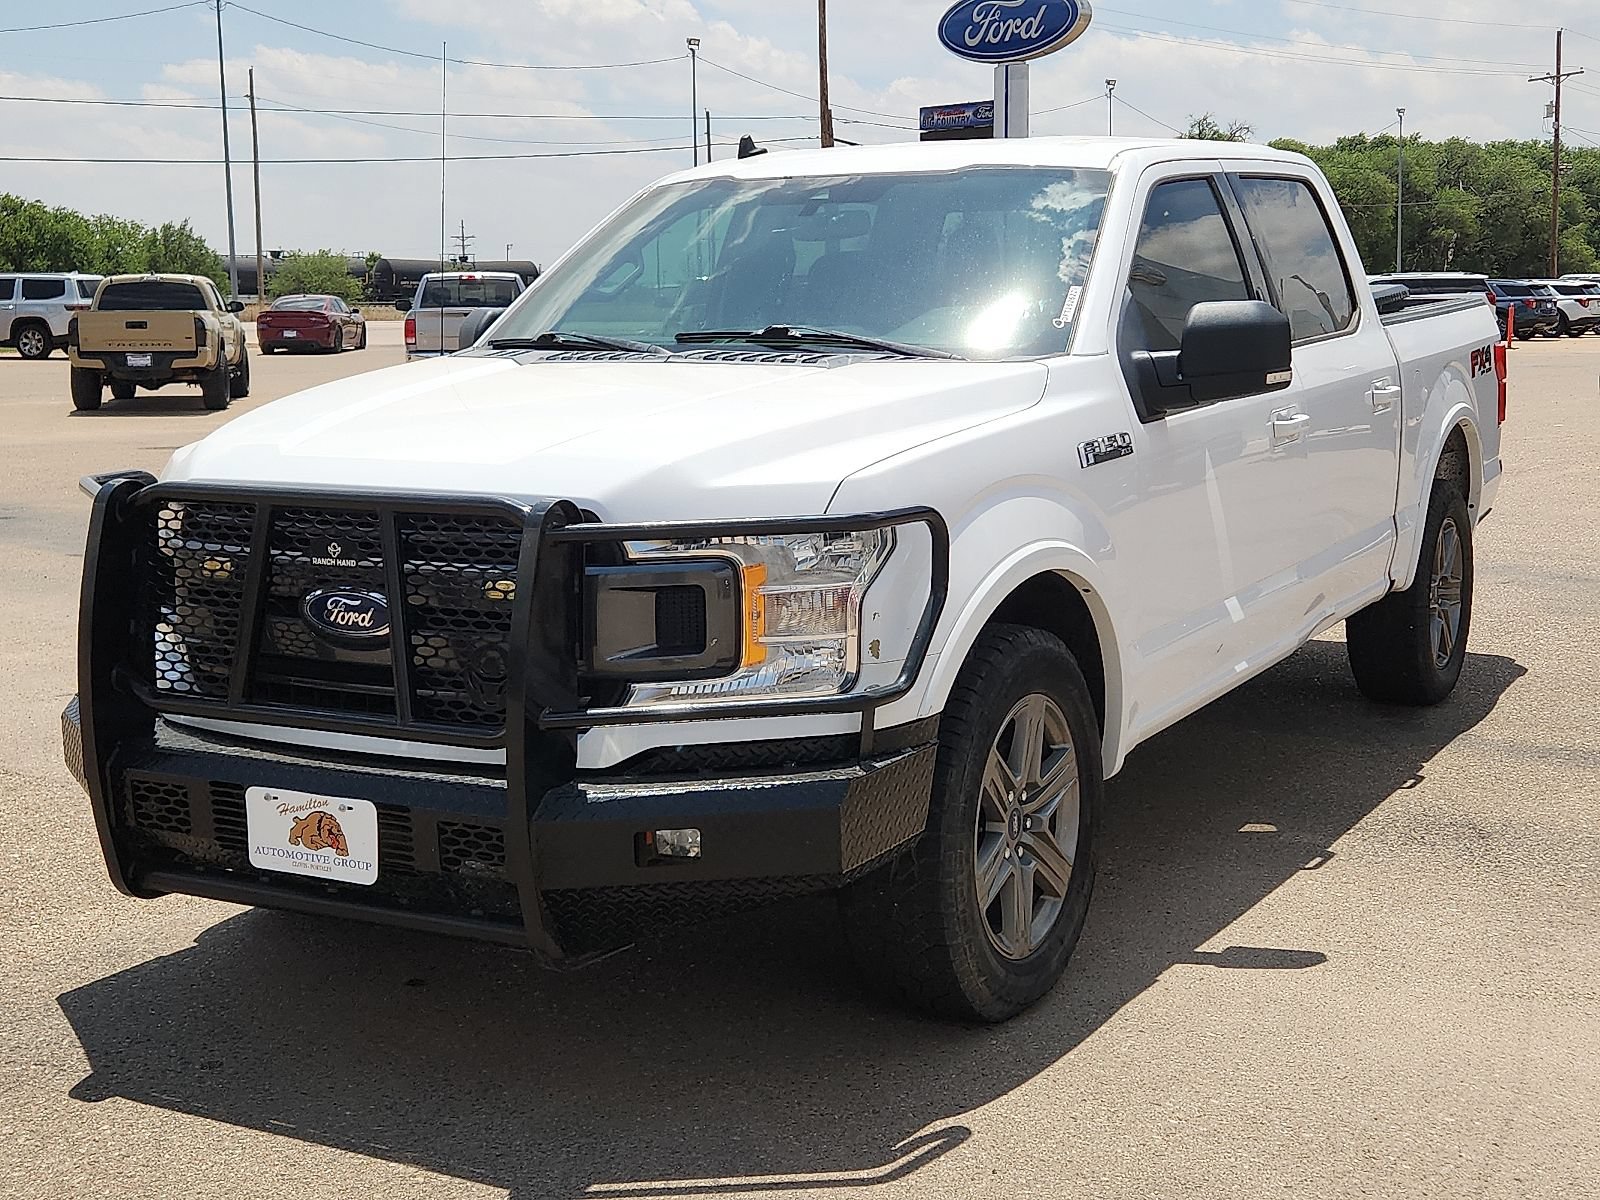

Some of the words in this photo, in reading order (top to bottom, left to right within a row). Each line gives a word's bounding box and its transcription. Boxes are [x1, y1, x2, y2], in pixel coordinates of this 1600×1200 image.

[964, 0, 1048, 47] Ford
[936, 113, 972, 128] COUNTRY
[1471, 344, 1492, 379] FX4
[312, 557, 336, 567] RANCH
[337, 559, 357, 567] HAND
[324, 596, 375, 628] Ford
[276, 798, 330, 816] Hamilton
[255, 846, 330, 864] AUTOMOTIVE
[333, 857, 373, 871] GROUP
